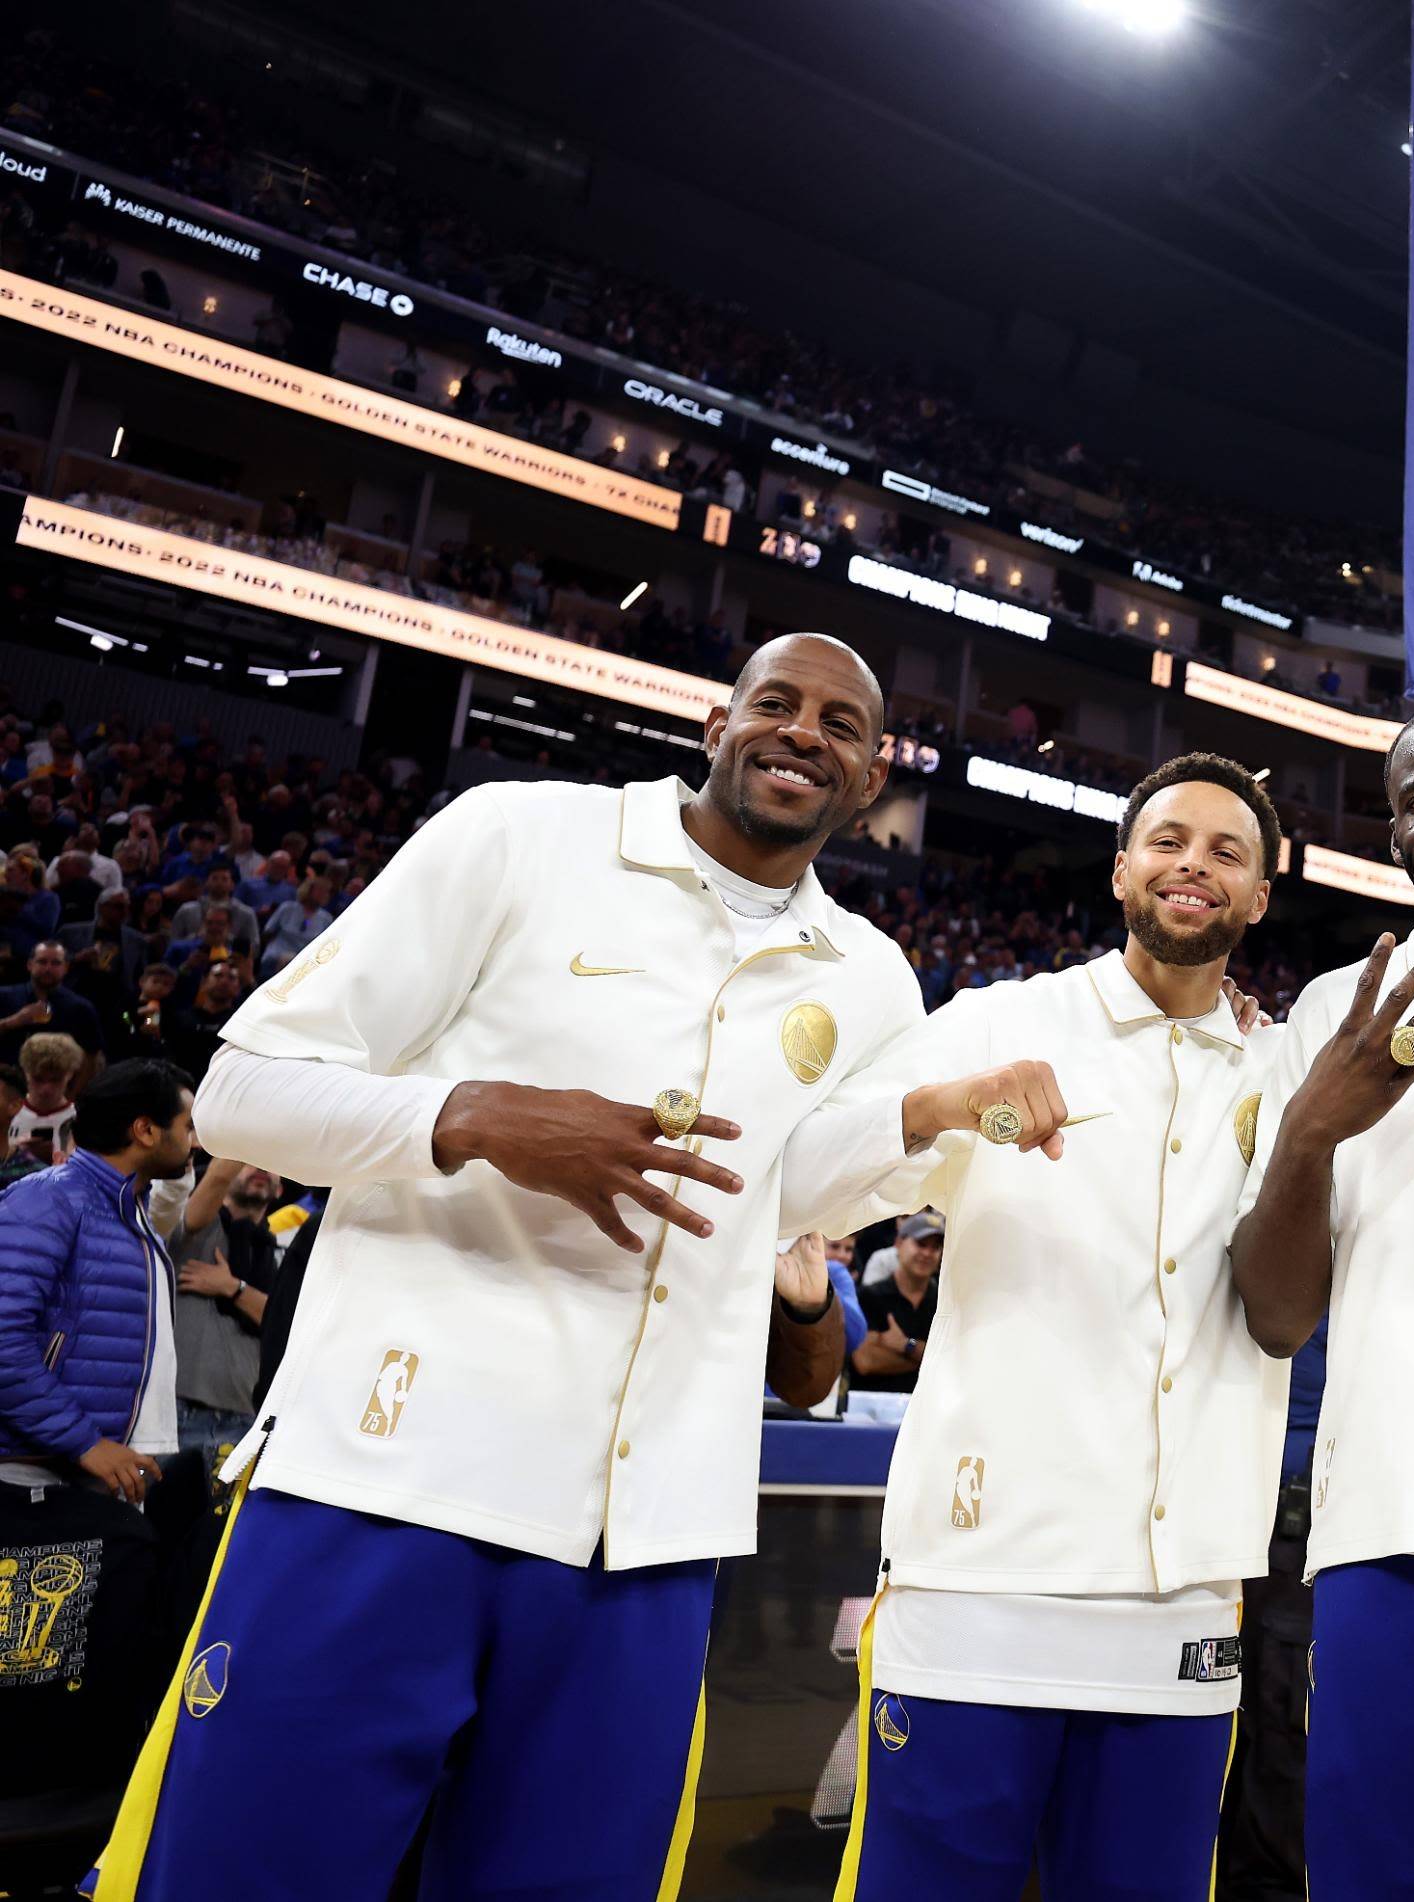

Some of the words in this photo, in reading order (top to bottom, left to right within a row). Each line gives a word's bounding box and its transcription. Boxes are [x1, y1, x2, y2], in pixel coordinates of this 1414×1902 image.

[113, 197, 165, 227] KAISER
[166, 216, 261, 261] PERMANENTE
[303, 262, 388, 309] CHASE
[30, 298, 97, 328] 2022
[104, 323, 156, 347] NBA
[162, 340, 304, 395] CHAMPIONS
[321, 392, 408, 428] GOLDEN
[486, 327, 562, 368] Rakuten
[623, 379, 724, 427] ORACLE
[159, 550, 226, 576] 2022
[233, 570, 285, 592] NBA
[291, 586, 433, 632] CHAMPIONS
[451, 628, 538, 660] GOLDEN
[544, 653, 607, 678] STATE
[362, 1411, 383, 1432] 75
[953, 1509, 966, 1526] 75
